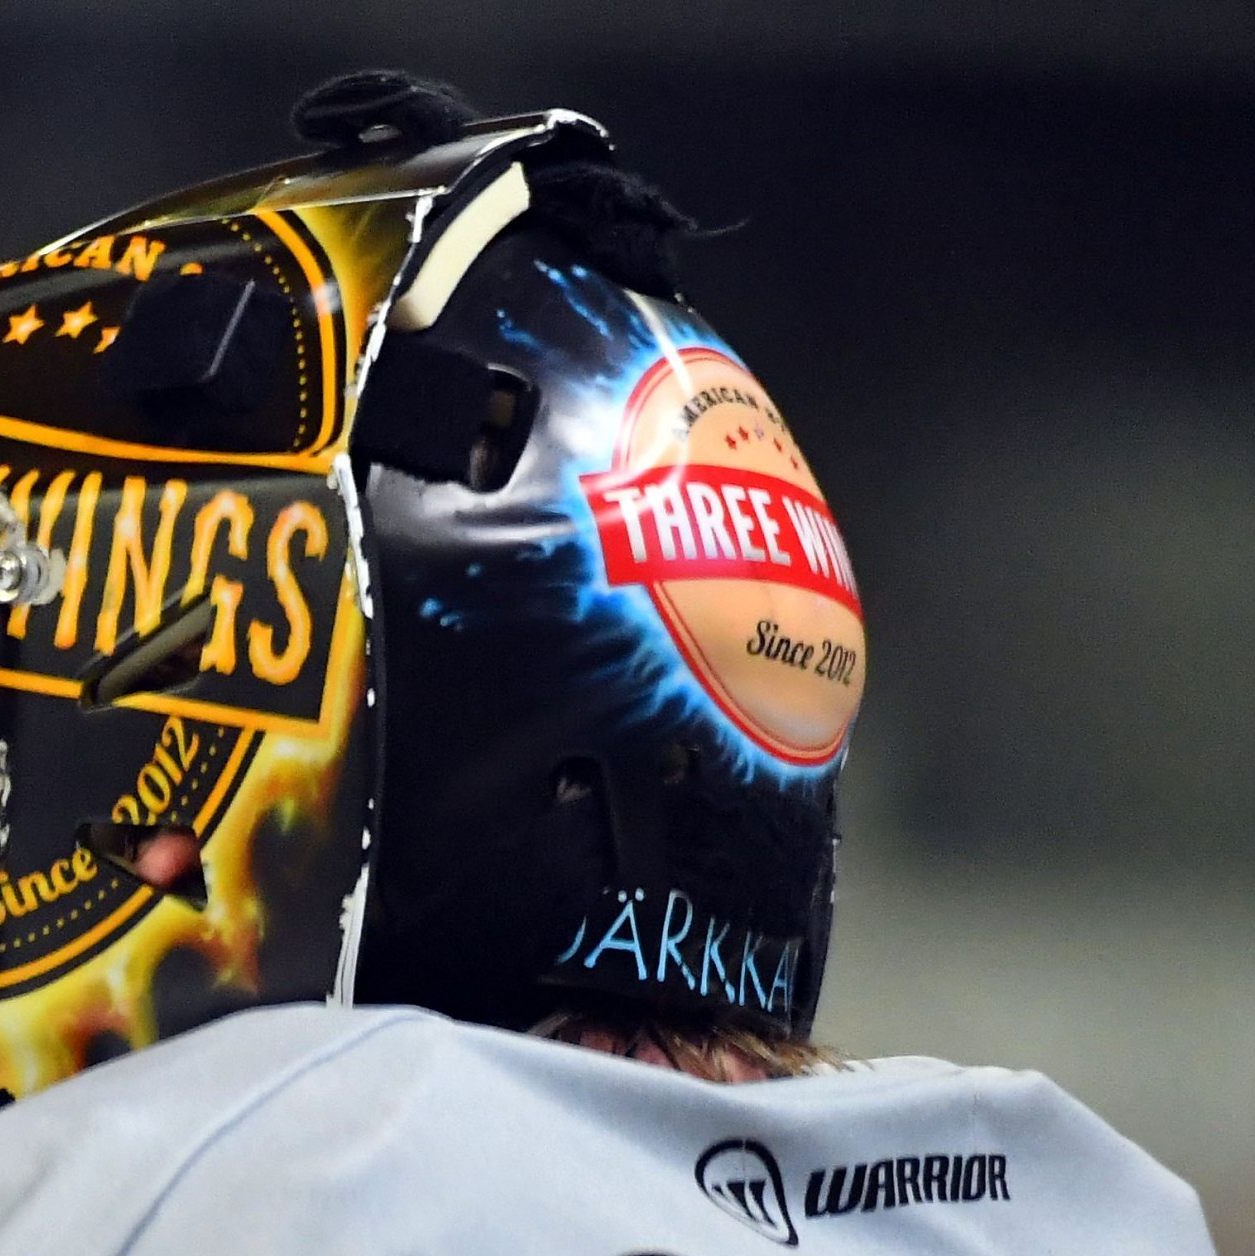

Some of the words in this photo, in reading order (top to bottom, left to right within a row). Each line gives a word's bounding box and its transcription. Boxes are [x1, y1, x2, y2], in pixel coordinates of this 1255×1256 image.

[604, 481, 791, 566] THREE
[747, 620, 814, 670] Since
[814, 638, 857, 686] 2012
[804, 1153, 1010, 1219] WARRIOR
